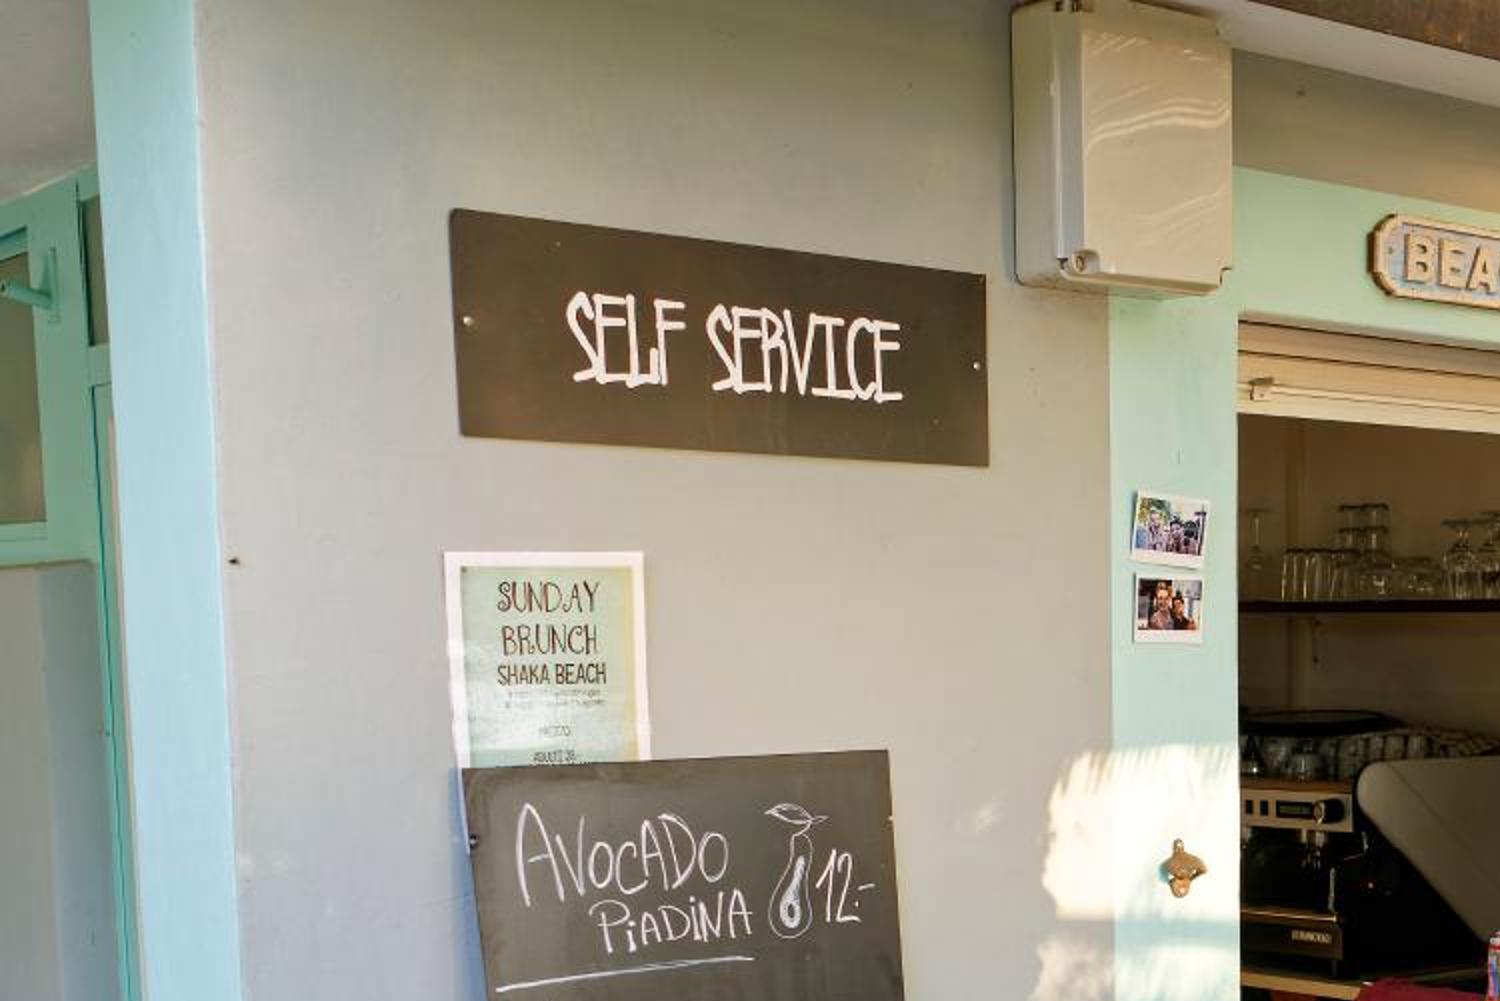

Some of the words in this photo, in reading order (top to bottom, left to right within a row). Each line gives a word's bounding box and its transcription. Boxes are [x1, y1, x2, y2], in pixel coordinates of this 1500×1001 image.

[565, 291, 686, 389] SELF
[705, 304, 903, 403] SERVICE
[497, 580, 601, 613] SUNDAY
[501, 624, 599, 655] BRUNCH
[497, 664, 551, 686] SHAKA
[555, 662, 608, 685] BEACH
[515, 803, 729, 907] AVOCADO
